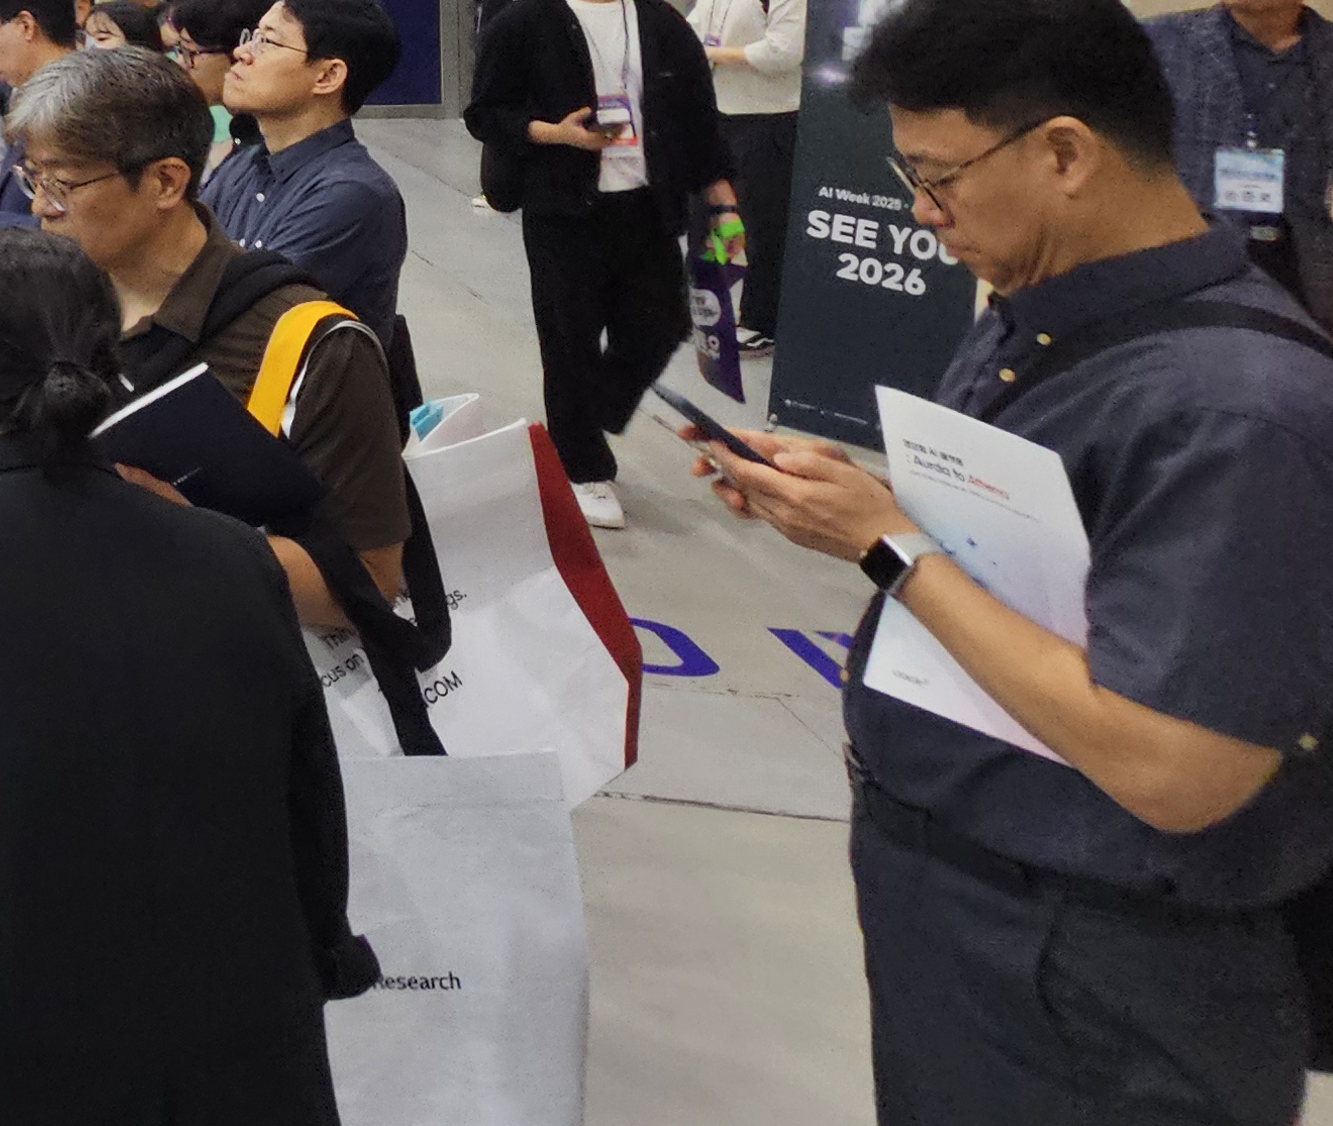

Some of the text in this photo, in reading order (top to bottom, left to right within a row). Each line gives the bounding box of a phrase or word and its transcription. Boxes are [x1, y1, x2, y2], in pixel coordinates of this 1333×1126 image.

[818, 186, 833, 199] AI
[836, 188, 870, 205] Week
[806, 209, 880, 249] SEE
[836, 252, 927, 296] 2026
